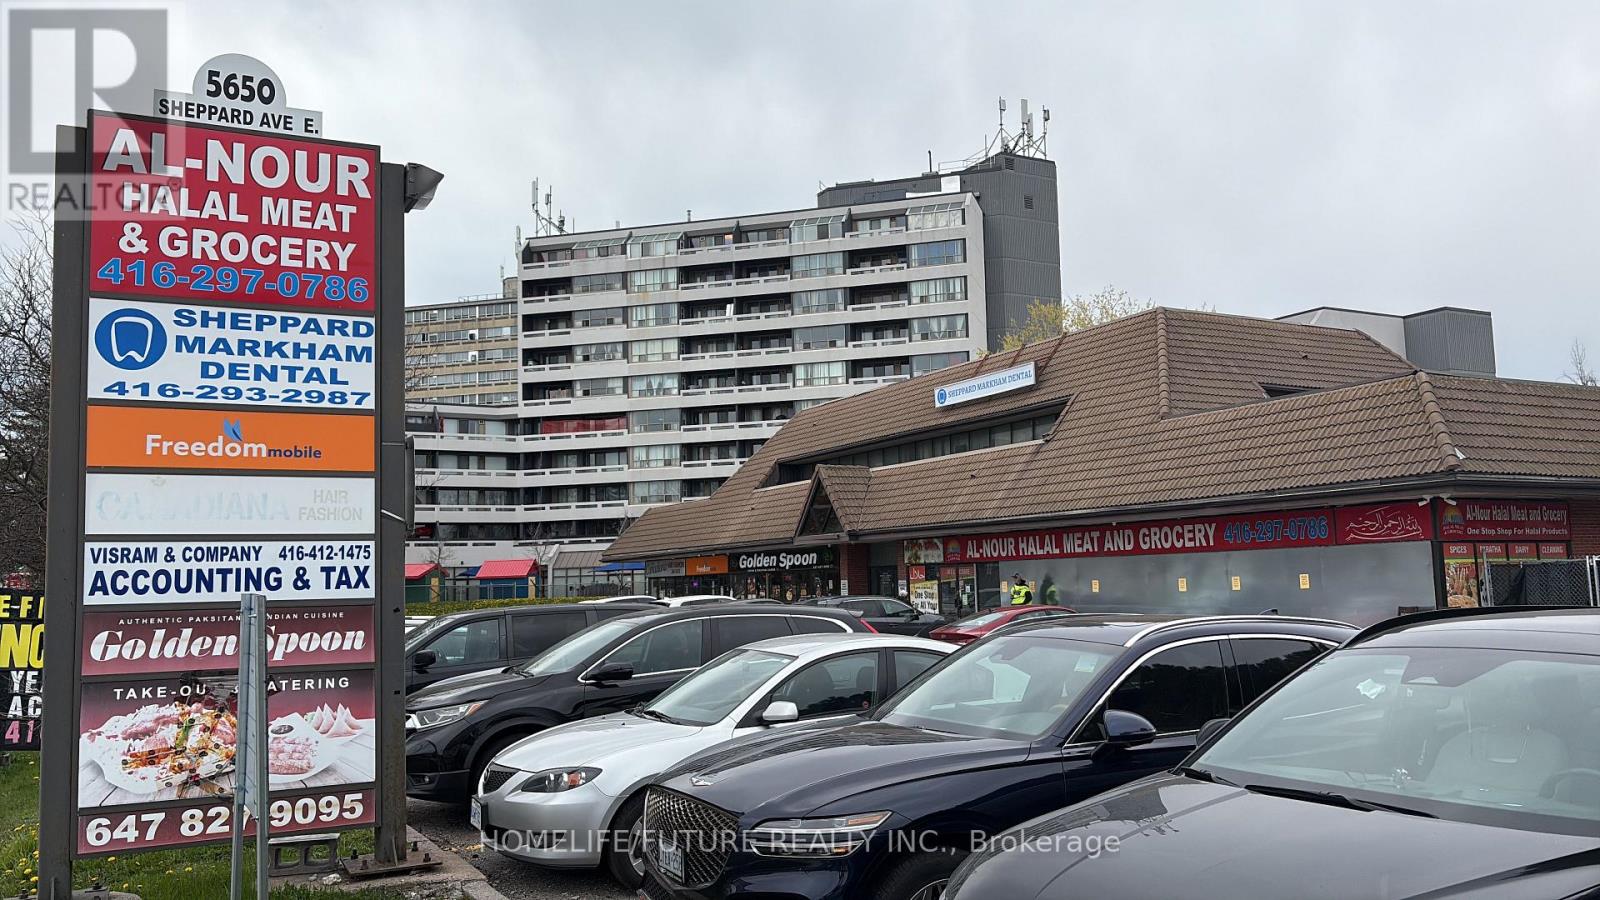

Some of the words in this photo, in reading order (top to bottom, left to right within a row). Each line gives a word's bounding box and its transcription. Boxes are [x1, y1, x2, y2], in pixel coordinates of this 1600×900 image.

[206, 69, 275, 105] 5650
[158, 98, 254, 126] SHEPPARD
[259, 111, 293, 131] AVE
[304, 118, 319, 134] E.
[103, 128, 372, 199] AL-NOUR
[123, 181, 249, 223] HALAL
[261, 196, 357, 233] MEAT
[118, 222, 149, 254] &
[158, 226, 357, 272] GROCERY
[97, 258, 369, 303] 416-297-0786
[173, 308, 374, 338] SHEPPARD
[175, 335, 373, 363] MARKHAM
[200, 361, 349, 386] DENTAL
[948, 385, 977, 398] SHEPPARD
[977, 377, 1006, 390] MARKHAM
[1008, 370, 1032, 382] DENTAL
[103, 381, 371, 406] 416-293-2987
[145, 434, 267, 458] Freedom
[267, 446, 322, 460] mobile
[313, 489, 349, 504] HAIR
[298, 506, 362, 521] FASHION
[1492, 504, 1510, 521] Halal
[1511, 505, 1527, 521] Meat
[1529, 505, 1541, 521] and
[1542, 506, 1567, 525] Grocery
[1018, 534, 1059, 556] HALAL
[1063, 531, 1100, 554] MEAT
[1103, 528, 1134, 552] AND
[1138, 523, 1216, 549] GROCERY
[1224, 516, 1329, 543] 416-297-0786
[1467, 527, 1479, 535] One
[1481, 527, 1496, 536] Stop
[1497, 527, 1512, 536] Shop
[1513, 527, 1524, 535] For
[1526, 527, 1540, 535] Halal
[1542, 527, 1568, 535] Products
[89, 547, 158, 564] VISRAM
[163, 547, 176, 563] &
[181, 546, 262, 562] COMPANY
[278, 545, 372, 561] 416-412-1475
[739, 553, 777, 569] Golden
[778, 552, 817, 570] Spoon
[1449, 545, 1468, 554] SPICES
[88, 566, 282, 597] ACCOUNTING
[292, 567, 311, 590] &
[320, 565, 370, 590] TAX
[118, 616, 183, 626] AUTHENTIC
[303, 611, 345, 620] CUISINE
[90, 627, 240, 662] Golden
[9, 671, 42, 693] YE
[113, 683, 207, 700] TAKE-OU
[5, 720, 41, 744] 41
[86, 812, 166, 847] 647
[270, 793, 364, 827] 9095
